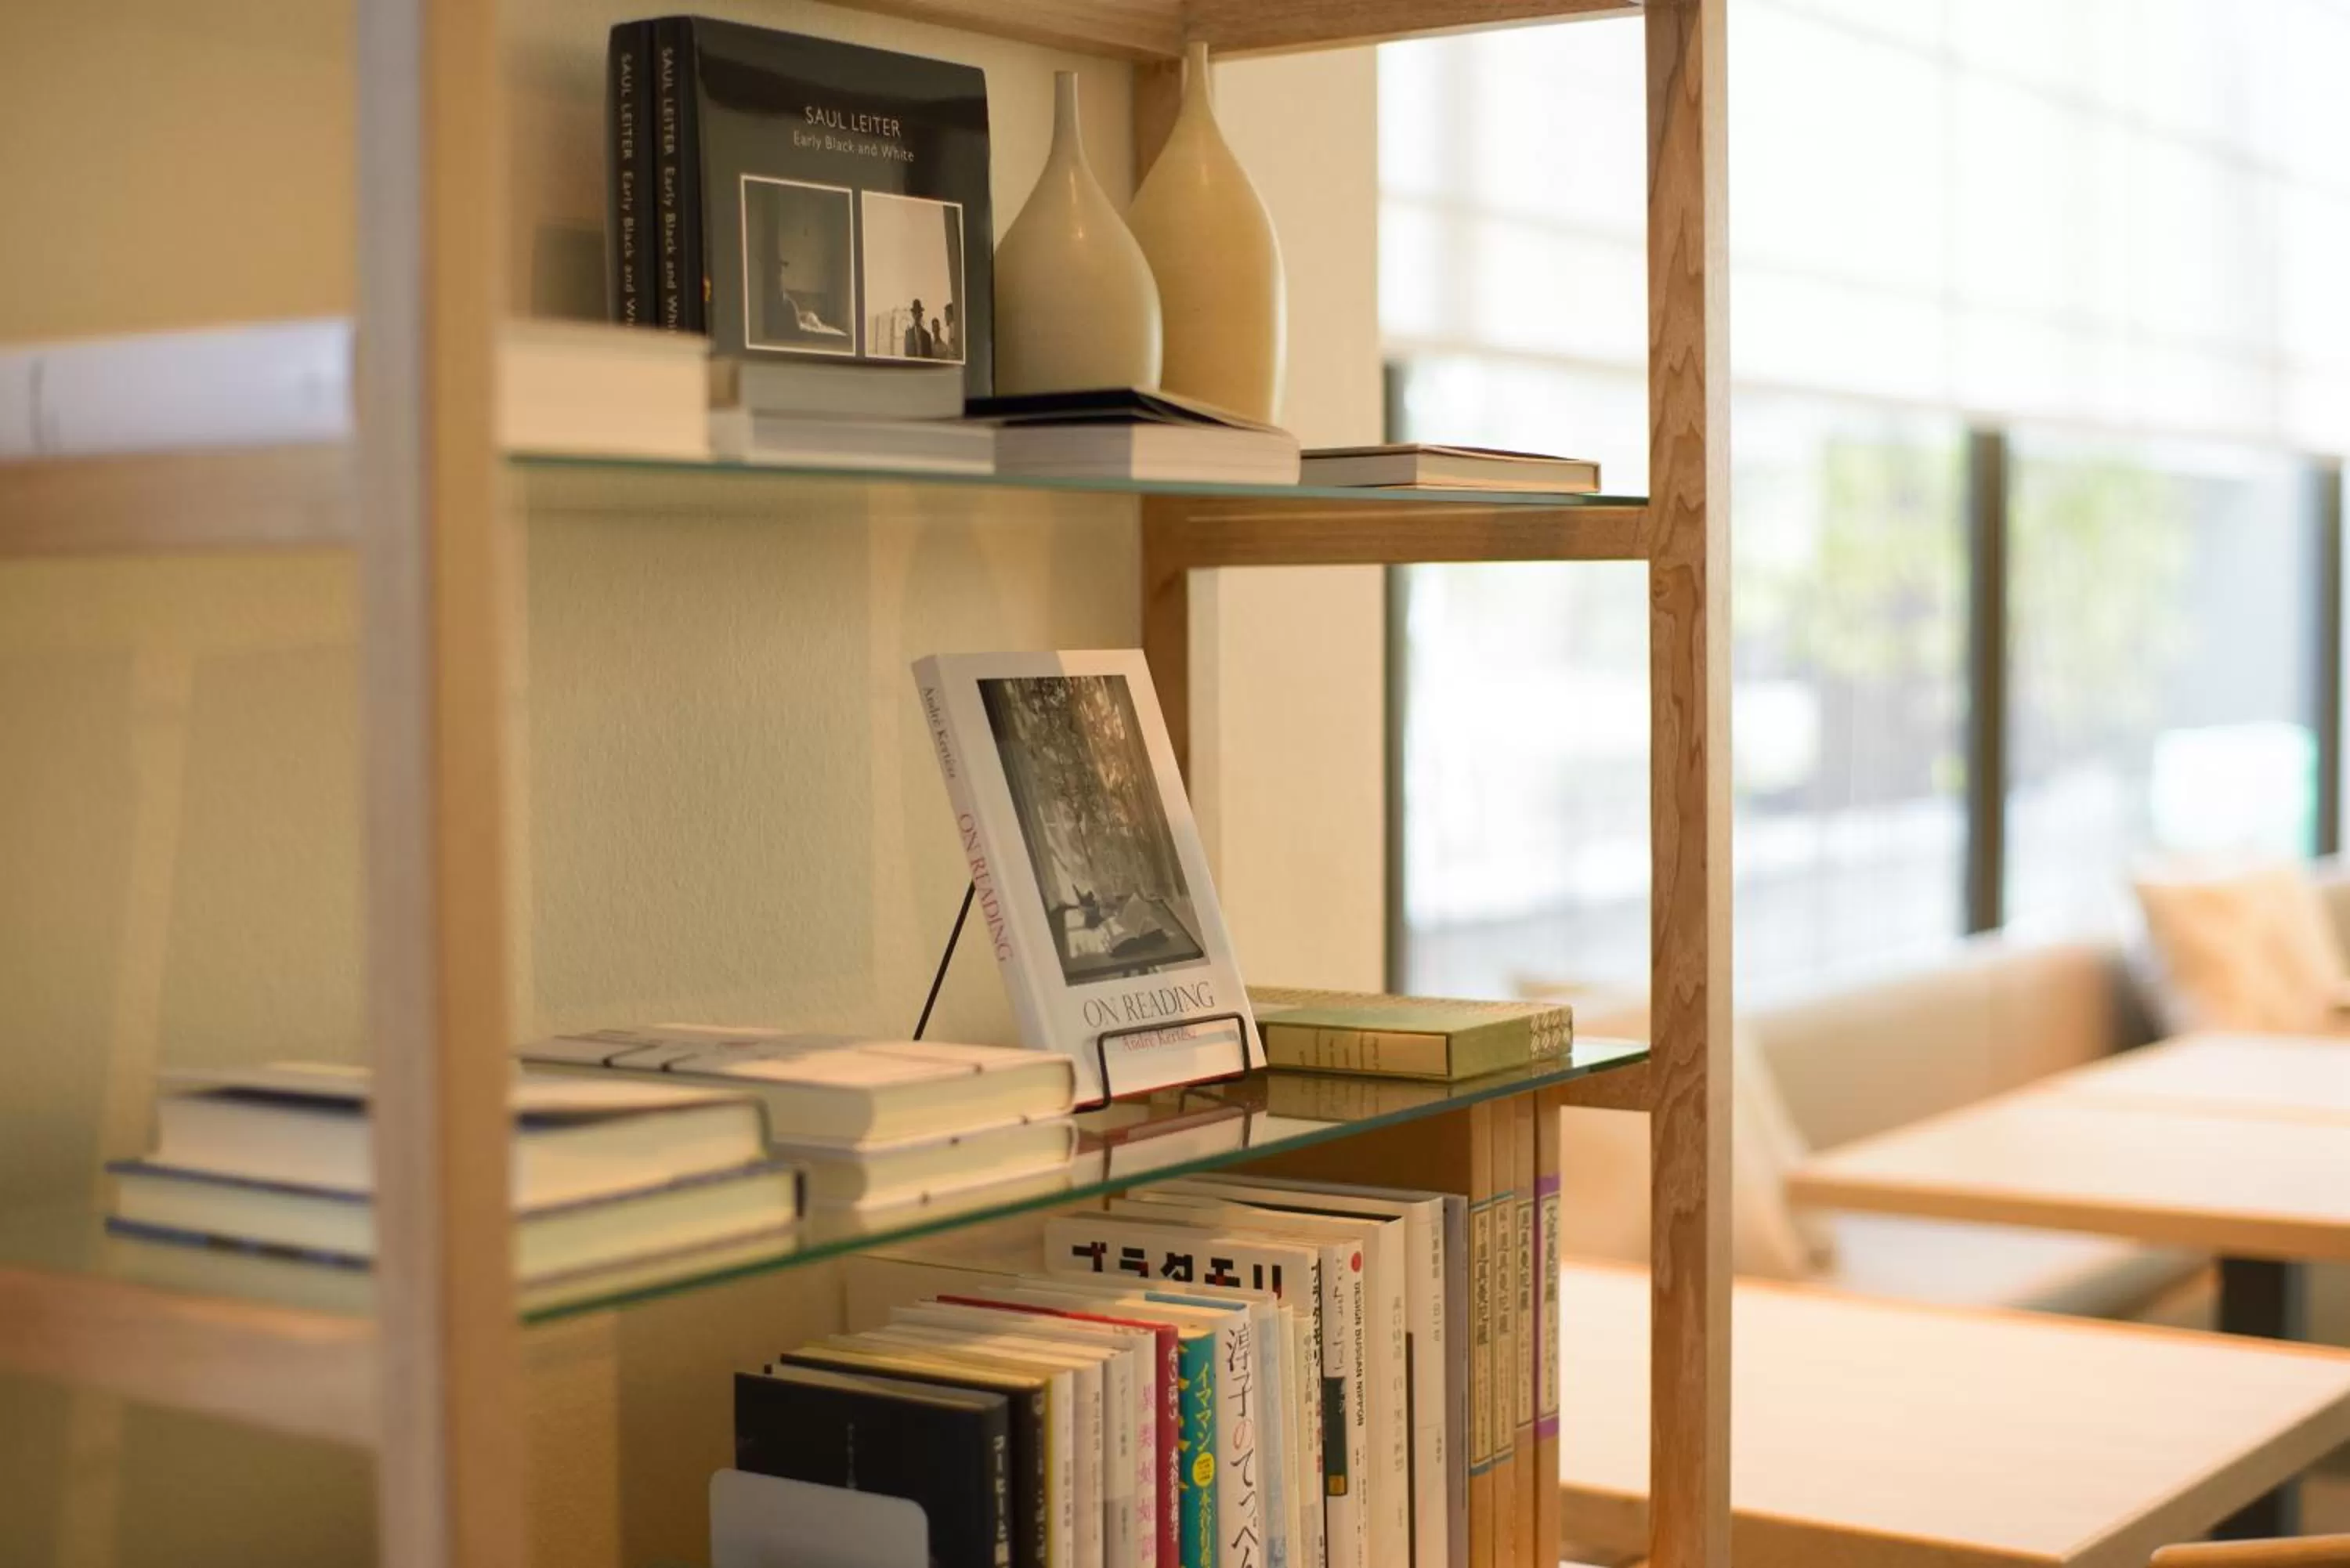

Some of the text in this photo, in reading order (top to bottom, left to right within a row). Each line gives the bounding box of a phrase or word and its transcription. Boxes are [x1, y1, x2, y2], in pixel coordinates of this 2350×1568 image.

[620, 52, 632, 97] SAUL
[662, 47, 674, 93] SAUL
[620, 103, 633, 159] LEITER
[663, 99, 674, 155] LEITER
[805, 106, 901, 138] SAUL LEITER
[794, 130, 915, 162] Early Black and White
[621, 172, 634, 210] Early
[663, 167, 675, 206] Early
[623, 217, 634, 258] Black
[666, 213, 677, 254] Black
[624, 265, 635, 292] and
[667, 261, 677, 289] and
[960, 814, 1013, 963] ON READING
[1083, 981, 1215, 1028] ON READING
[1354, 1282, 1362, 1325] DESIGN
[1355, 1382, 1365, 1427] NIPPON
